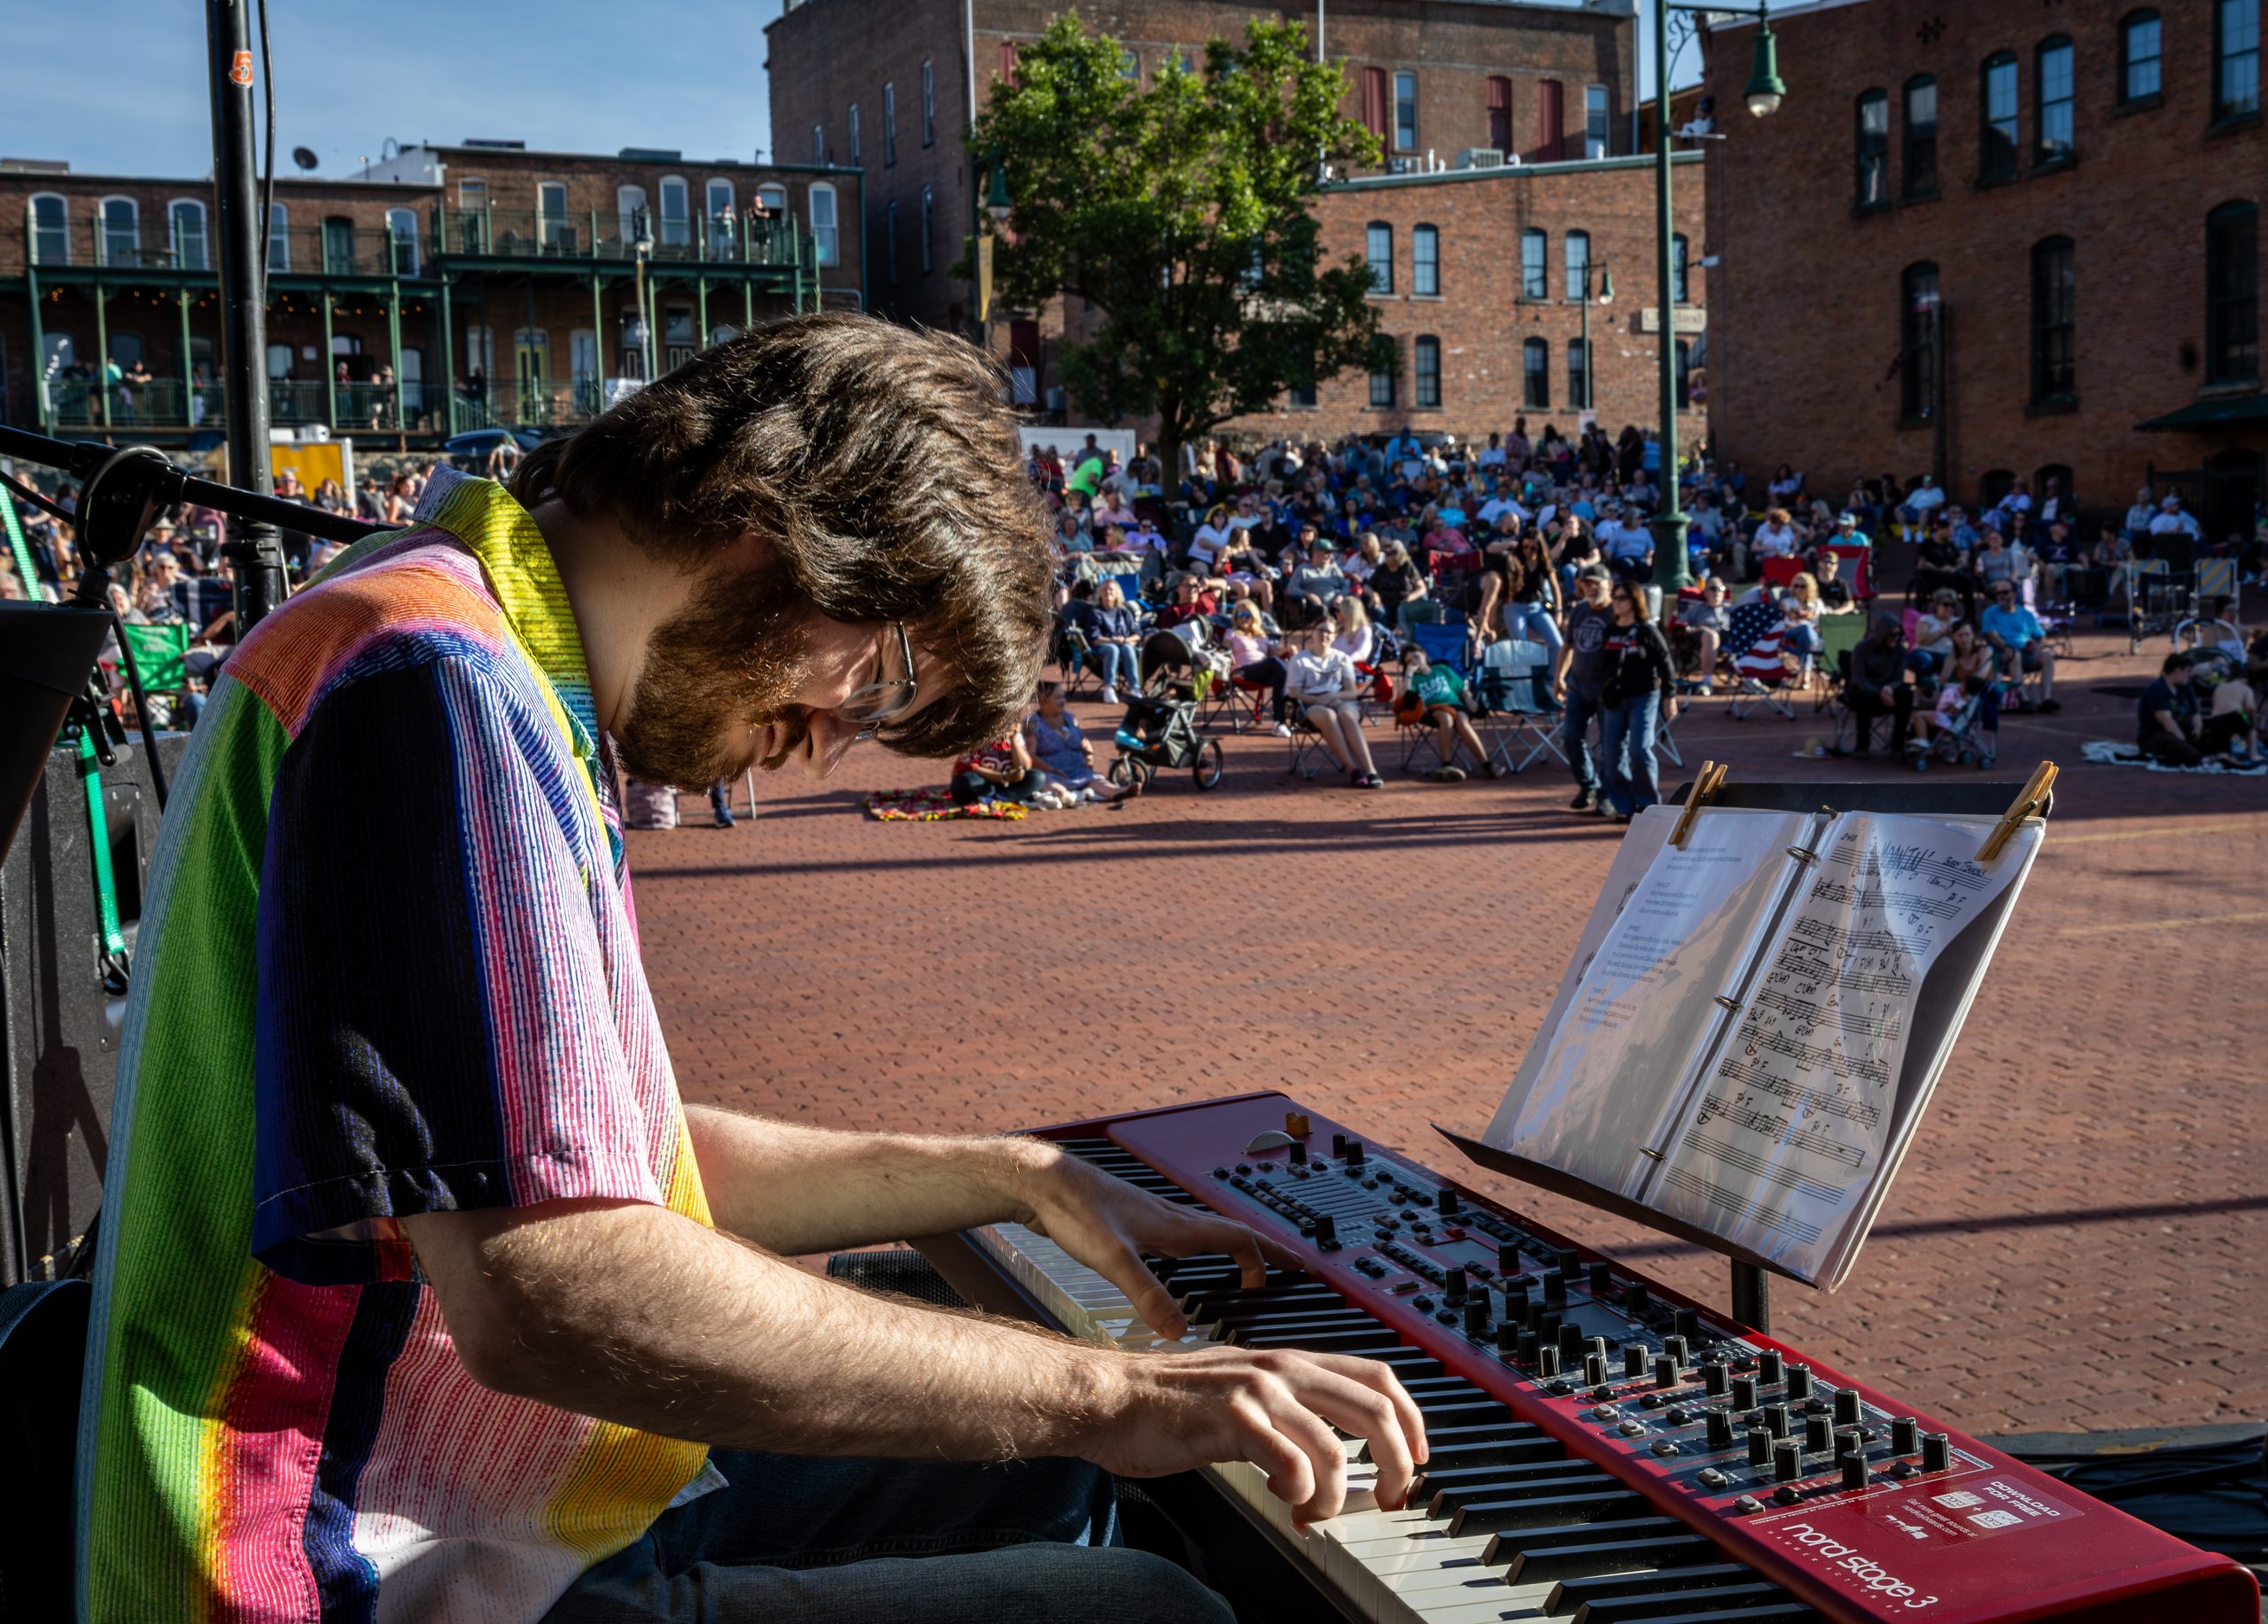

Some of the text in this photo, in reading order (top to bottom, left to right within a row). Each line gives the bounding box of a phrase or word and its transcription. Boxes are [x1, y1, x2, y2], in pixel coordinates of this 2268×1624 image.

[1983, 1487, 2042, 1517] FOR FREE
[1990, 1480, 2061, 1517] DOWNLOAD
[1918, 1504, 1935, 1514] more
[1930, 1512, 1950, 1522] great
[1946, 1520, 1971, 1534] sounds
[1782, 1523, 1938, 1608] nord stage 3
